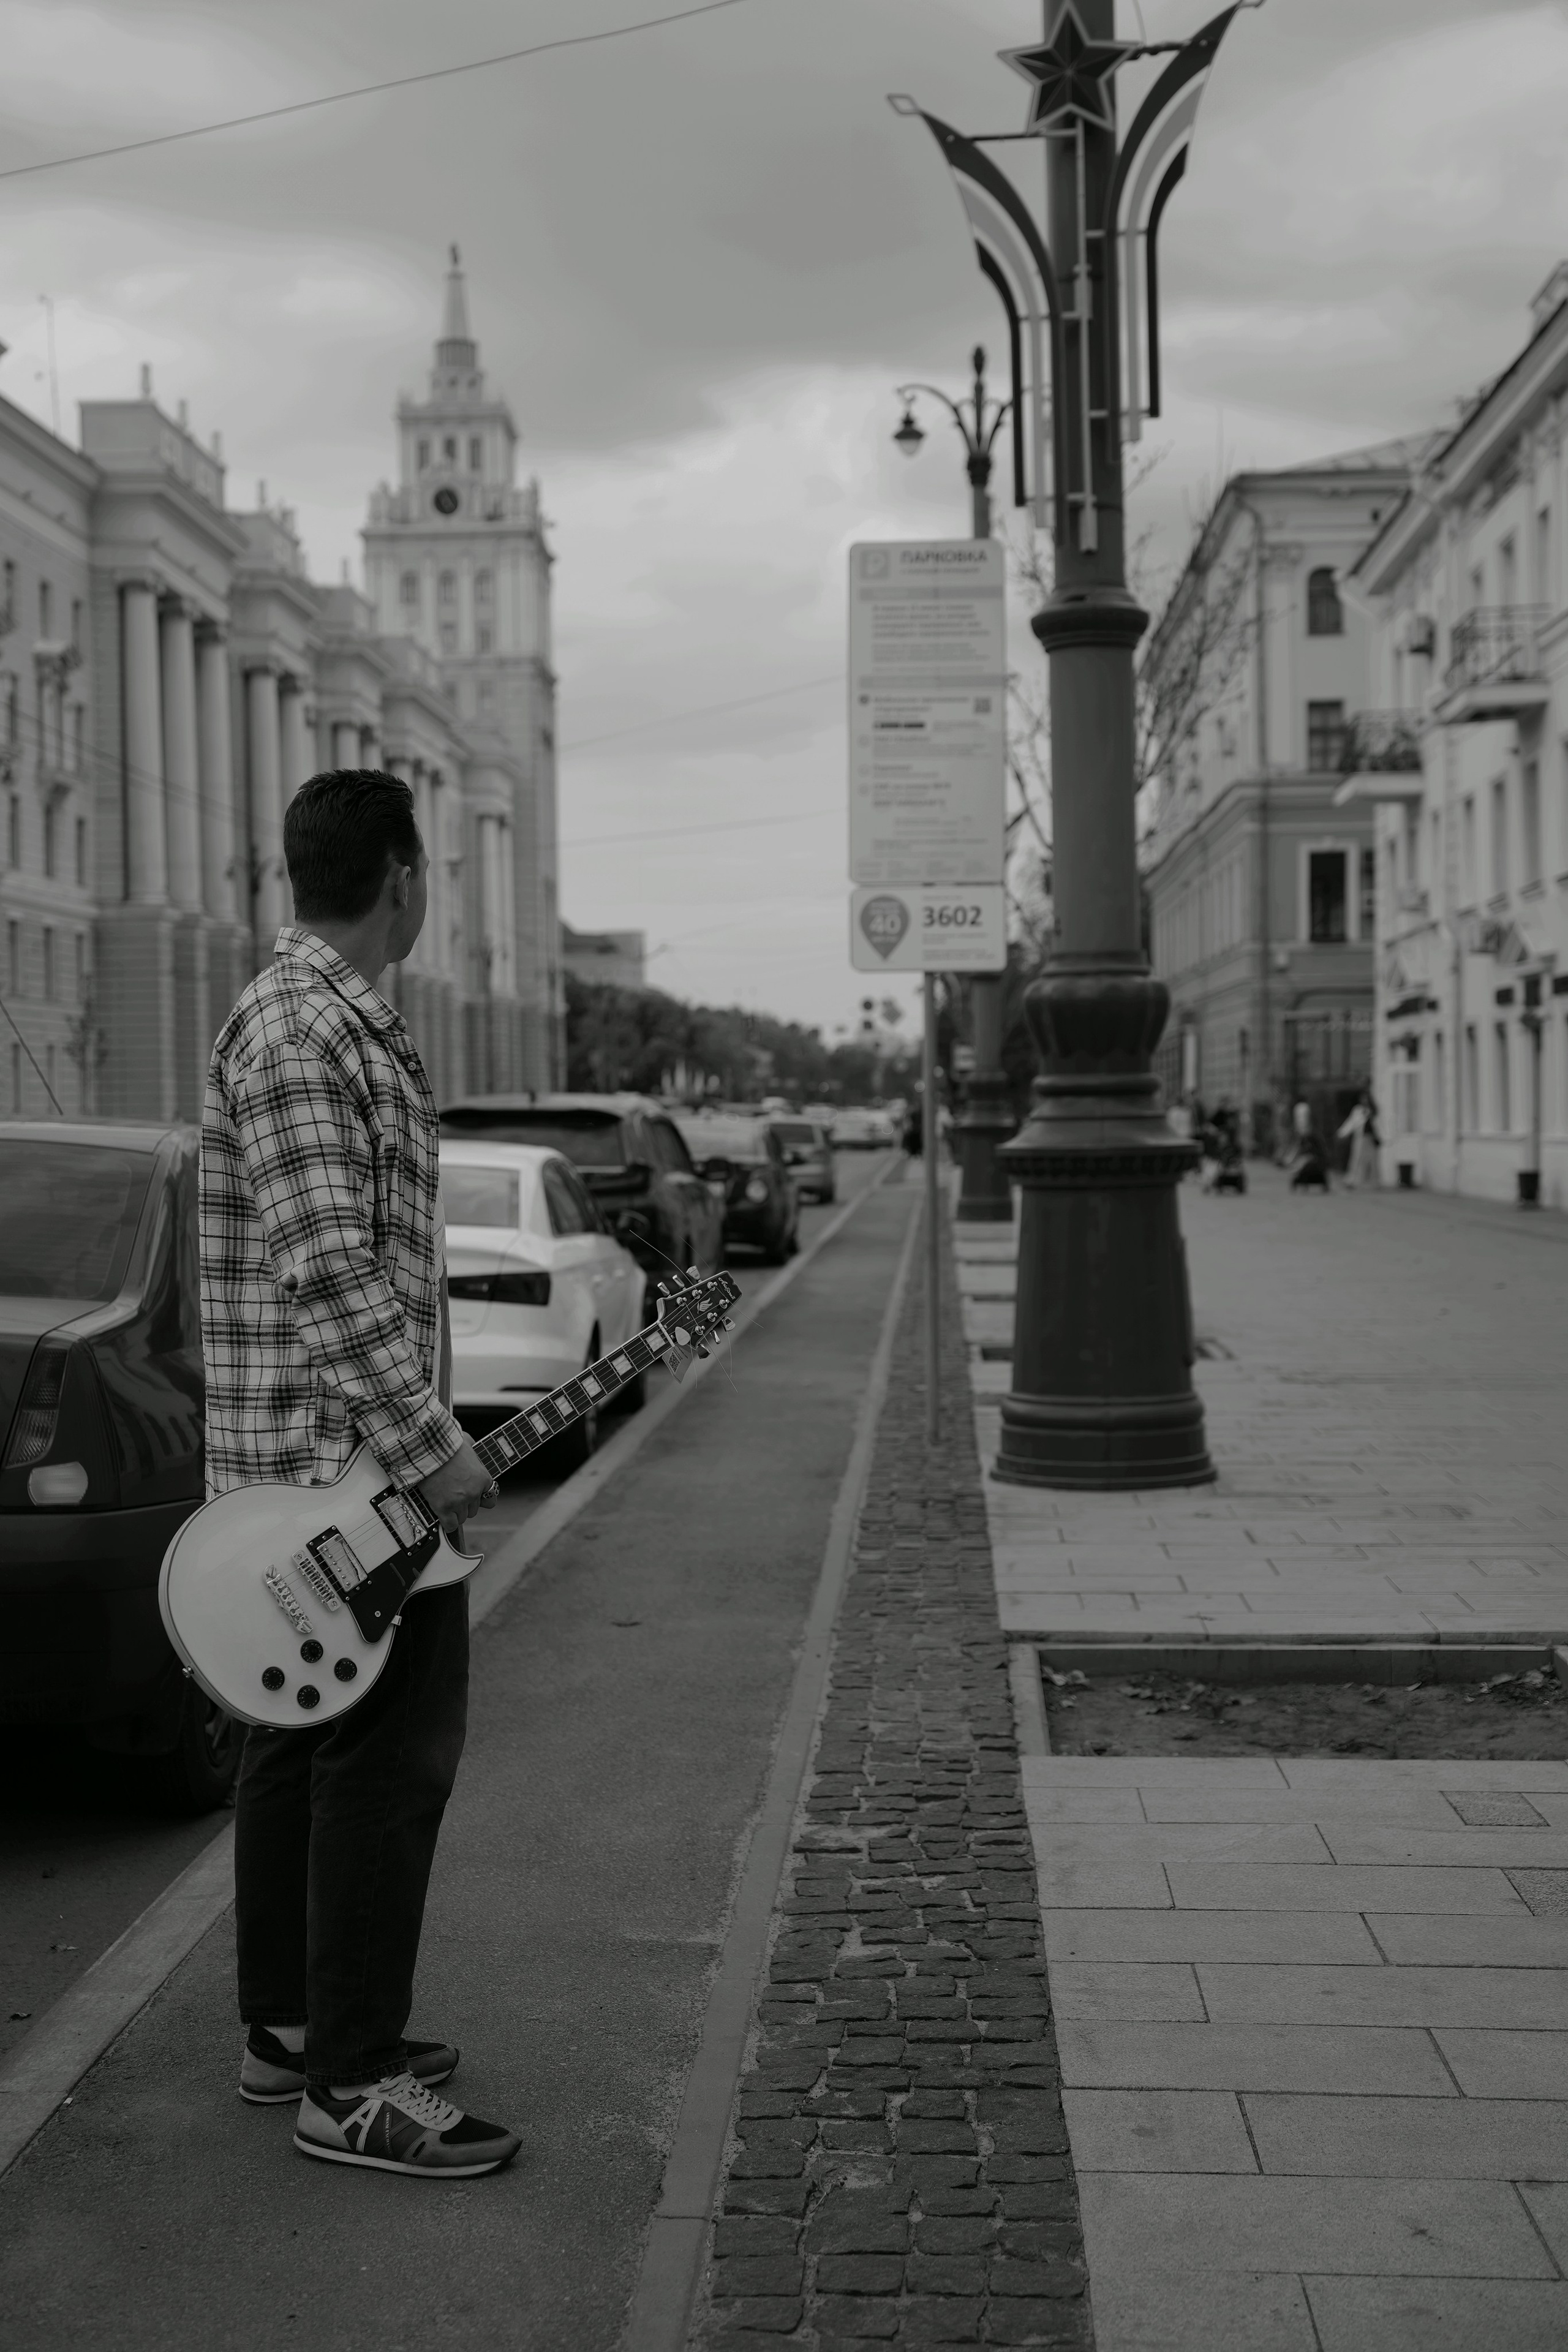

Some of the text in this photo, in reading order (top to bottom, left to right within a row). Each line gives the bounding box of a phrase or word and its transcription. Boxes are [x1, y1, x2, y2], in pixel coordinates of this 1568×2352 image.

[900, 549, 988, 564] ПАРКОВКА
[869, 913, 902, 935] 40
[922, 905, 983, 929] 3602
